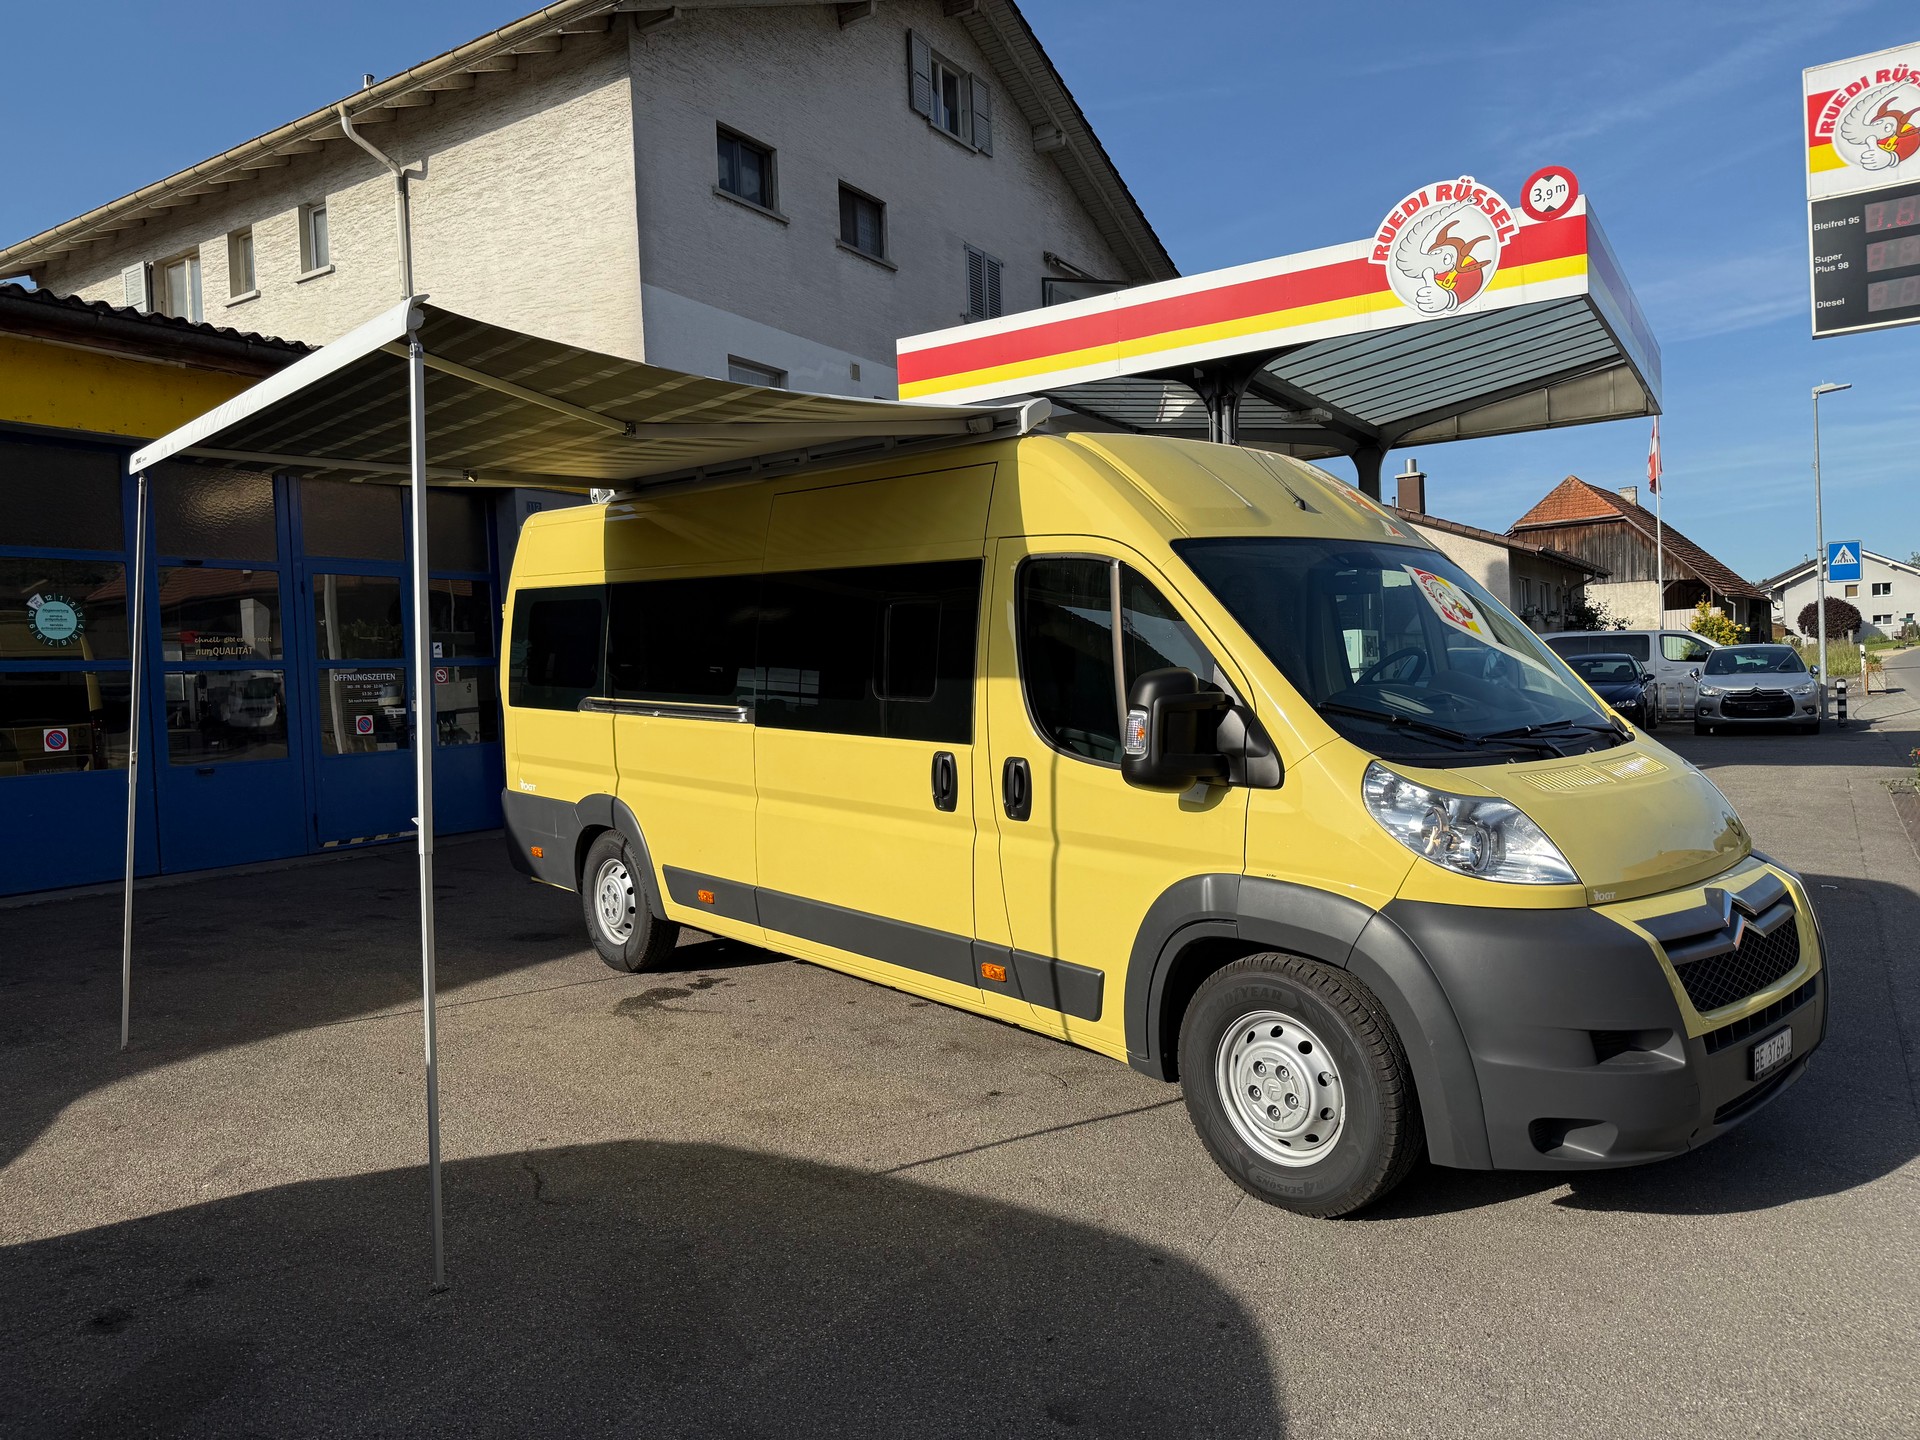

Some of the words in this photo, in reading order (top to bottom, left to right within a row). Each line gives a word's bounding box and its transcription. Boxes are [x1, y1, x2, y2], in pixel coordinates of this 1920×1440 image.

[1818, 75, 1870, 134] RUEDI
[1875, 63, 1920, 88] RÜS
[1533, 186, 1553, 203] 3,9
[1555, 183, 1566, 193] m
[1372, 190, 1430, 261] RUEDI
[1435, 178, 1517, 243] RÜSSEL
[1813, 218, 1846, 231] Bleifrei
[1848, 215, 1860, 225] 95
[1814, 253, 1843, 264] Super
[1815, 265, 1836, 274] Plus
[1837, 261, 1849, 270] 98
[1816, 297, 1845, 309] Diesel
[333, 672, 396, 682] ÖFFNUNGSZEITEN
